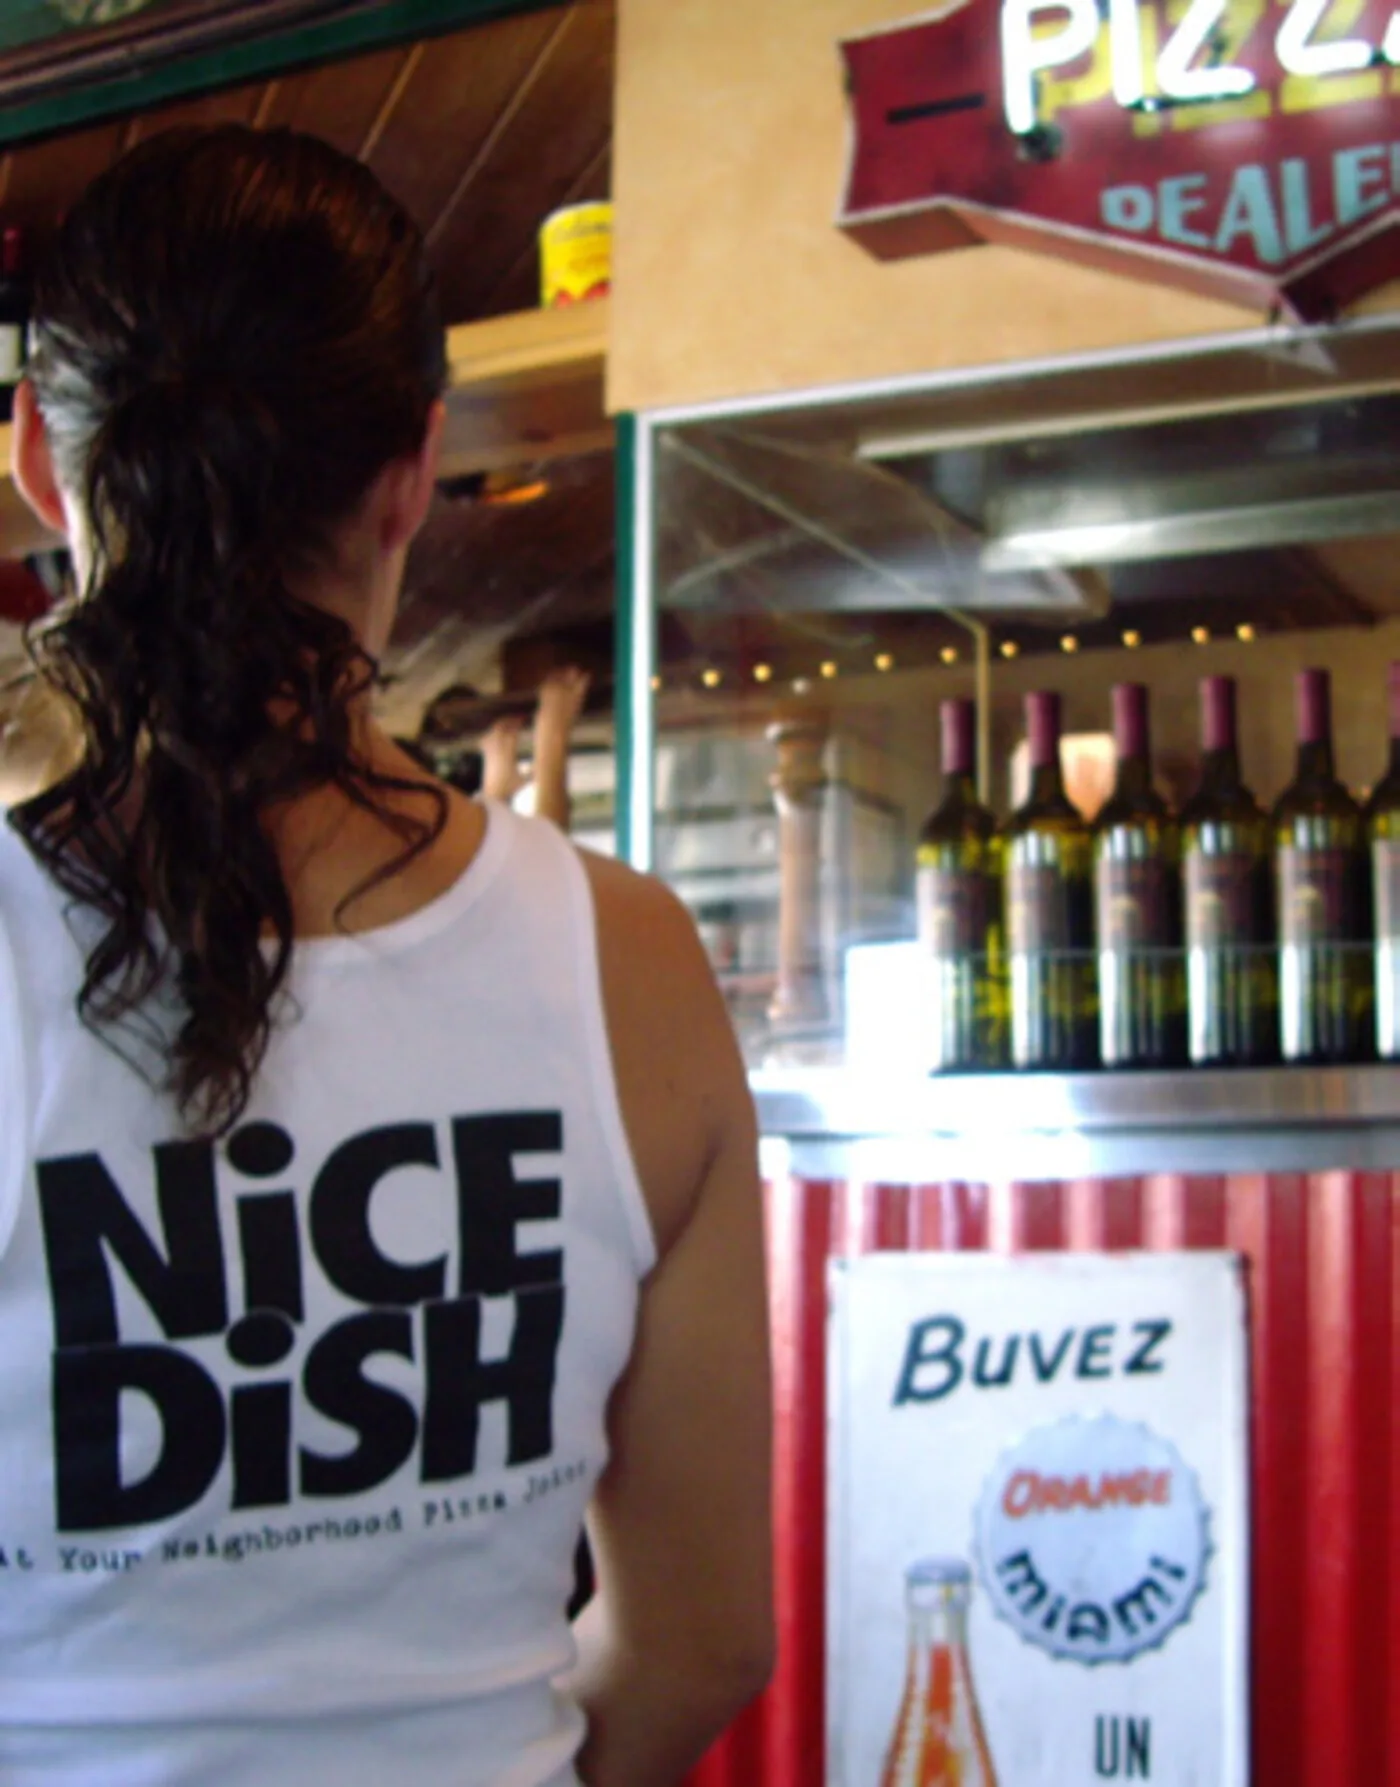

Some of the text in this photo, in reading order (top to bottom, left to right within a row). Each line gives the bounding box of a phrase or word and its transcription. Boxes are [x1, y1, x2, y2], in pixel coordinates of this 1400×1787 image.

[1000, 0, 1400, 137] PIZZ
[1003, 1468, 1171, 1518] ORANGE
[59, 1546, 141, 1572] Your
[161, 1505, 403, 1564] Neighborhood
[422, 1491, 506, 1528] Pizza
[1095, 1714, 1150, 1778] UN
